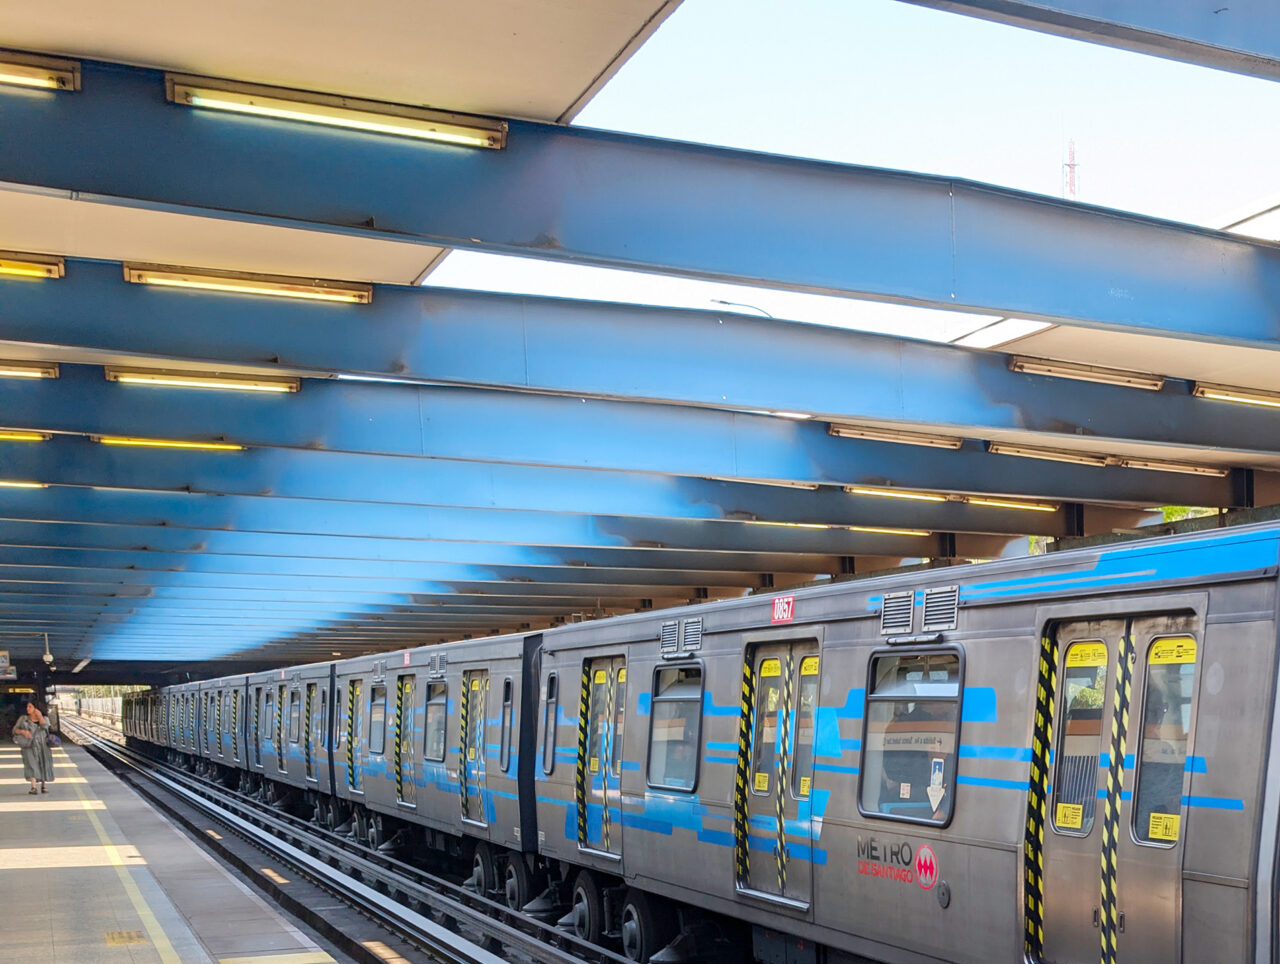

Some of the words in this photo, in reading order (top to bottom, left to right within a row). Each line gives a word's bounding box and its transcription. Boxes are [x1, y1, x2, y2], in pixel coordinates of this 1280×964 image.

[857, 836, 912, 866] METRO
[857, 861, 870, 875] DE
[871, 864, 914, 884] SANTIAGO
